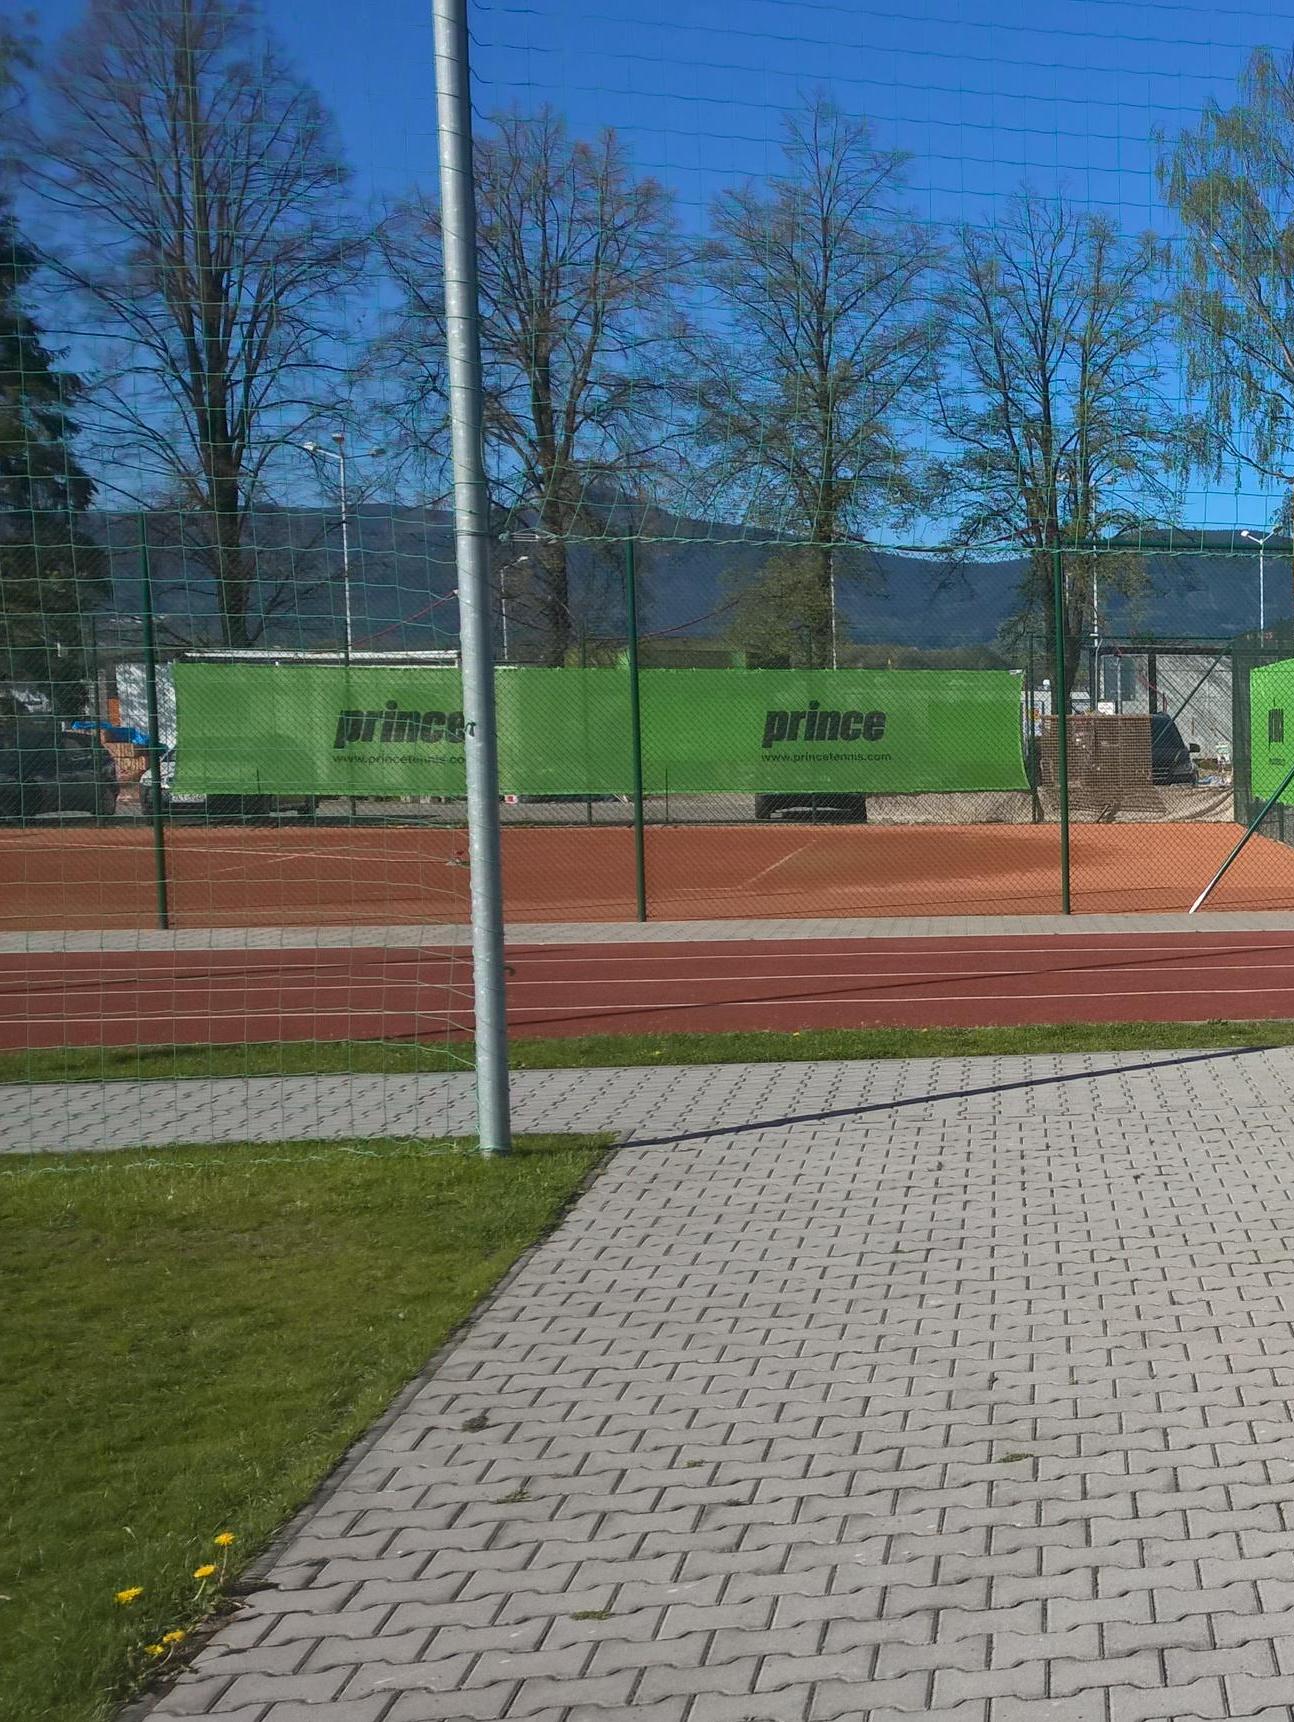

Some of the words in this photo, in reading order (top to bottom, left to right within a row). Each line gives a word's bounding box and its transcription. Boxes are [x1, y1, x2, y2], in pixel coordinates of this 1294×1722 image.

[334, 700, 465, 749] prince
[762, 700, 887, 748] prince
[333, 754, 466, 765] www.princetennis.co
[761, 751, 892, 763] www.princetennis.com
